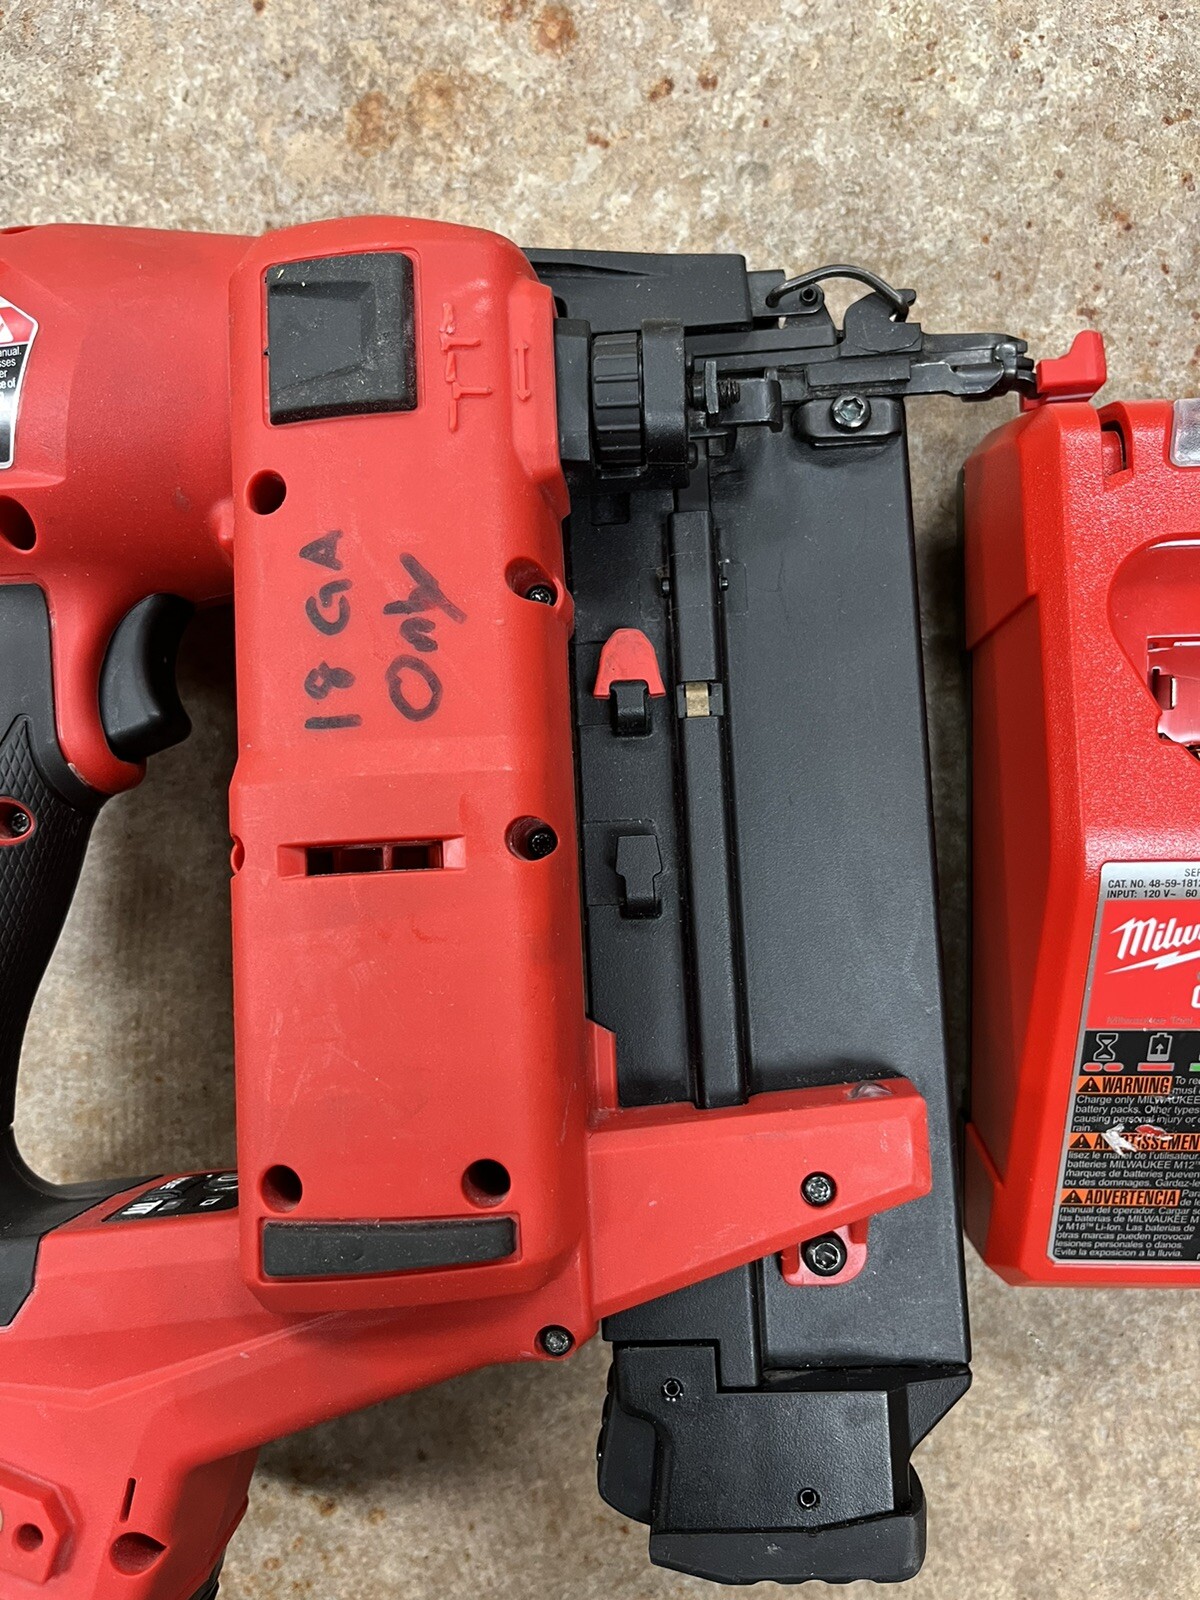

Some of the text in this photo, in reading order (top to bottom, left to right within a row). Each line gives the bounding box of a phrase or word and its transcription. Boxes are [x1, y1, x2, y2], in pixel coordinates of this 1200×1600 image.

[7, 377, 16, 389] of
[299, 529, 363, 730] 18 GA
[1108, 879, 1128, 888] CAT.
[1130, 879, 1146, 888] NO.
[1107, 889, 1137, 898] INPUT:
[1143, 889, 1161, 898] 120
[1185, 889, 1198, 898] 60
[1102, 1076, 1170, 1093] WARNING
[1174, 1076, 1186, 1085] To
[1076, 1095, 1200, 1106] Charge only MILWAUKEE
[1075, 1104, 1200, 1116] battery packs. Other types
[1073, 1115, 1110, 1125] causing
[1113, 1114, 1155, 1125] personal
[1185, 1116, 1197, 1124] or
[1072, 1124, 1093, 1132] rain.
[1092, 1151, 1101, 1160] le
[1134, 1151, 1147, 1160] de
[1067, 1160, 1107, 1169] batteries
[1109, 1160, 1171, 1169] MILWAUKEE
[1066, 1169, 1106, 1179] marques
[1109, 1169, 1121, 1178] de
[1123, 1169, 1163, 1178] batteries
[1064, 1179, 1076, 1187] ou
[1079, 1178, 1096, 1187] des
[1098, 1178, 1152, 1189] dommages.
[1084, 1189, 1177, 1205] ADVERTENCIA
[1180, 1198, 1192, 1206] de
[1060, 1206, 1095, 1215] manual
[1096, 1206, 1110, 1215] del
[1112, 1206, 1155, 1217] operador.
[1158, 1206, 1190, 1218] Cargar
[1059, 1215, 1073, 1224] las
[1113, 1215, 1126, 1224] de
[1127, 1215, 1188, 1224] MILWAUKEE
[1057, 1224, 1065, 1233] y
[1126, 1223, 1143, 1232] Las
[1184, 1224, 1196, 1233] de
[1056, 1232, 1194, 1242] otras marcas pueden provocar
[1055, 1240, 1092, 1249] lesiones
[1094, 1240, 1144, 1251] personales
[1145, 1242, 1152, 1250] o
[1054, 1249, 1077, 1257] Evite
[1078, 1249, 1087, 1257] la
[1139, 1250, 1145, 1258] a
[1147, 1249, 1156, 1258] la
[1158, 1249, 1183, 1258] lluvia.
